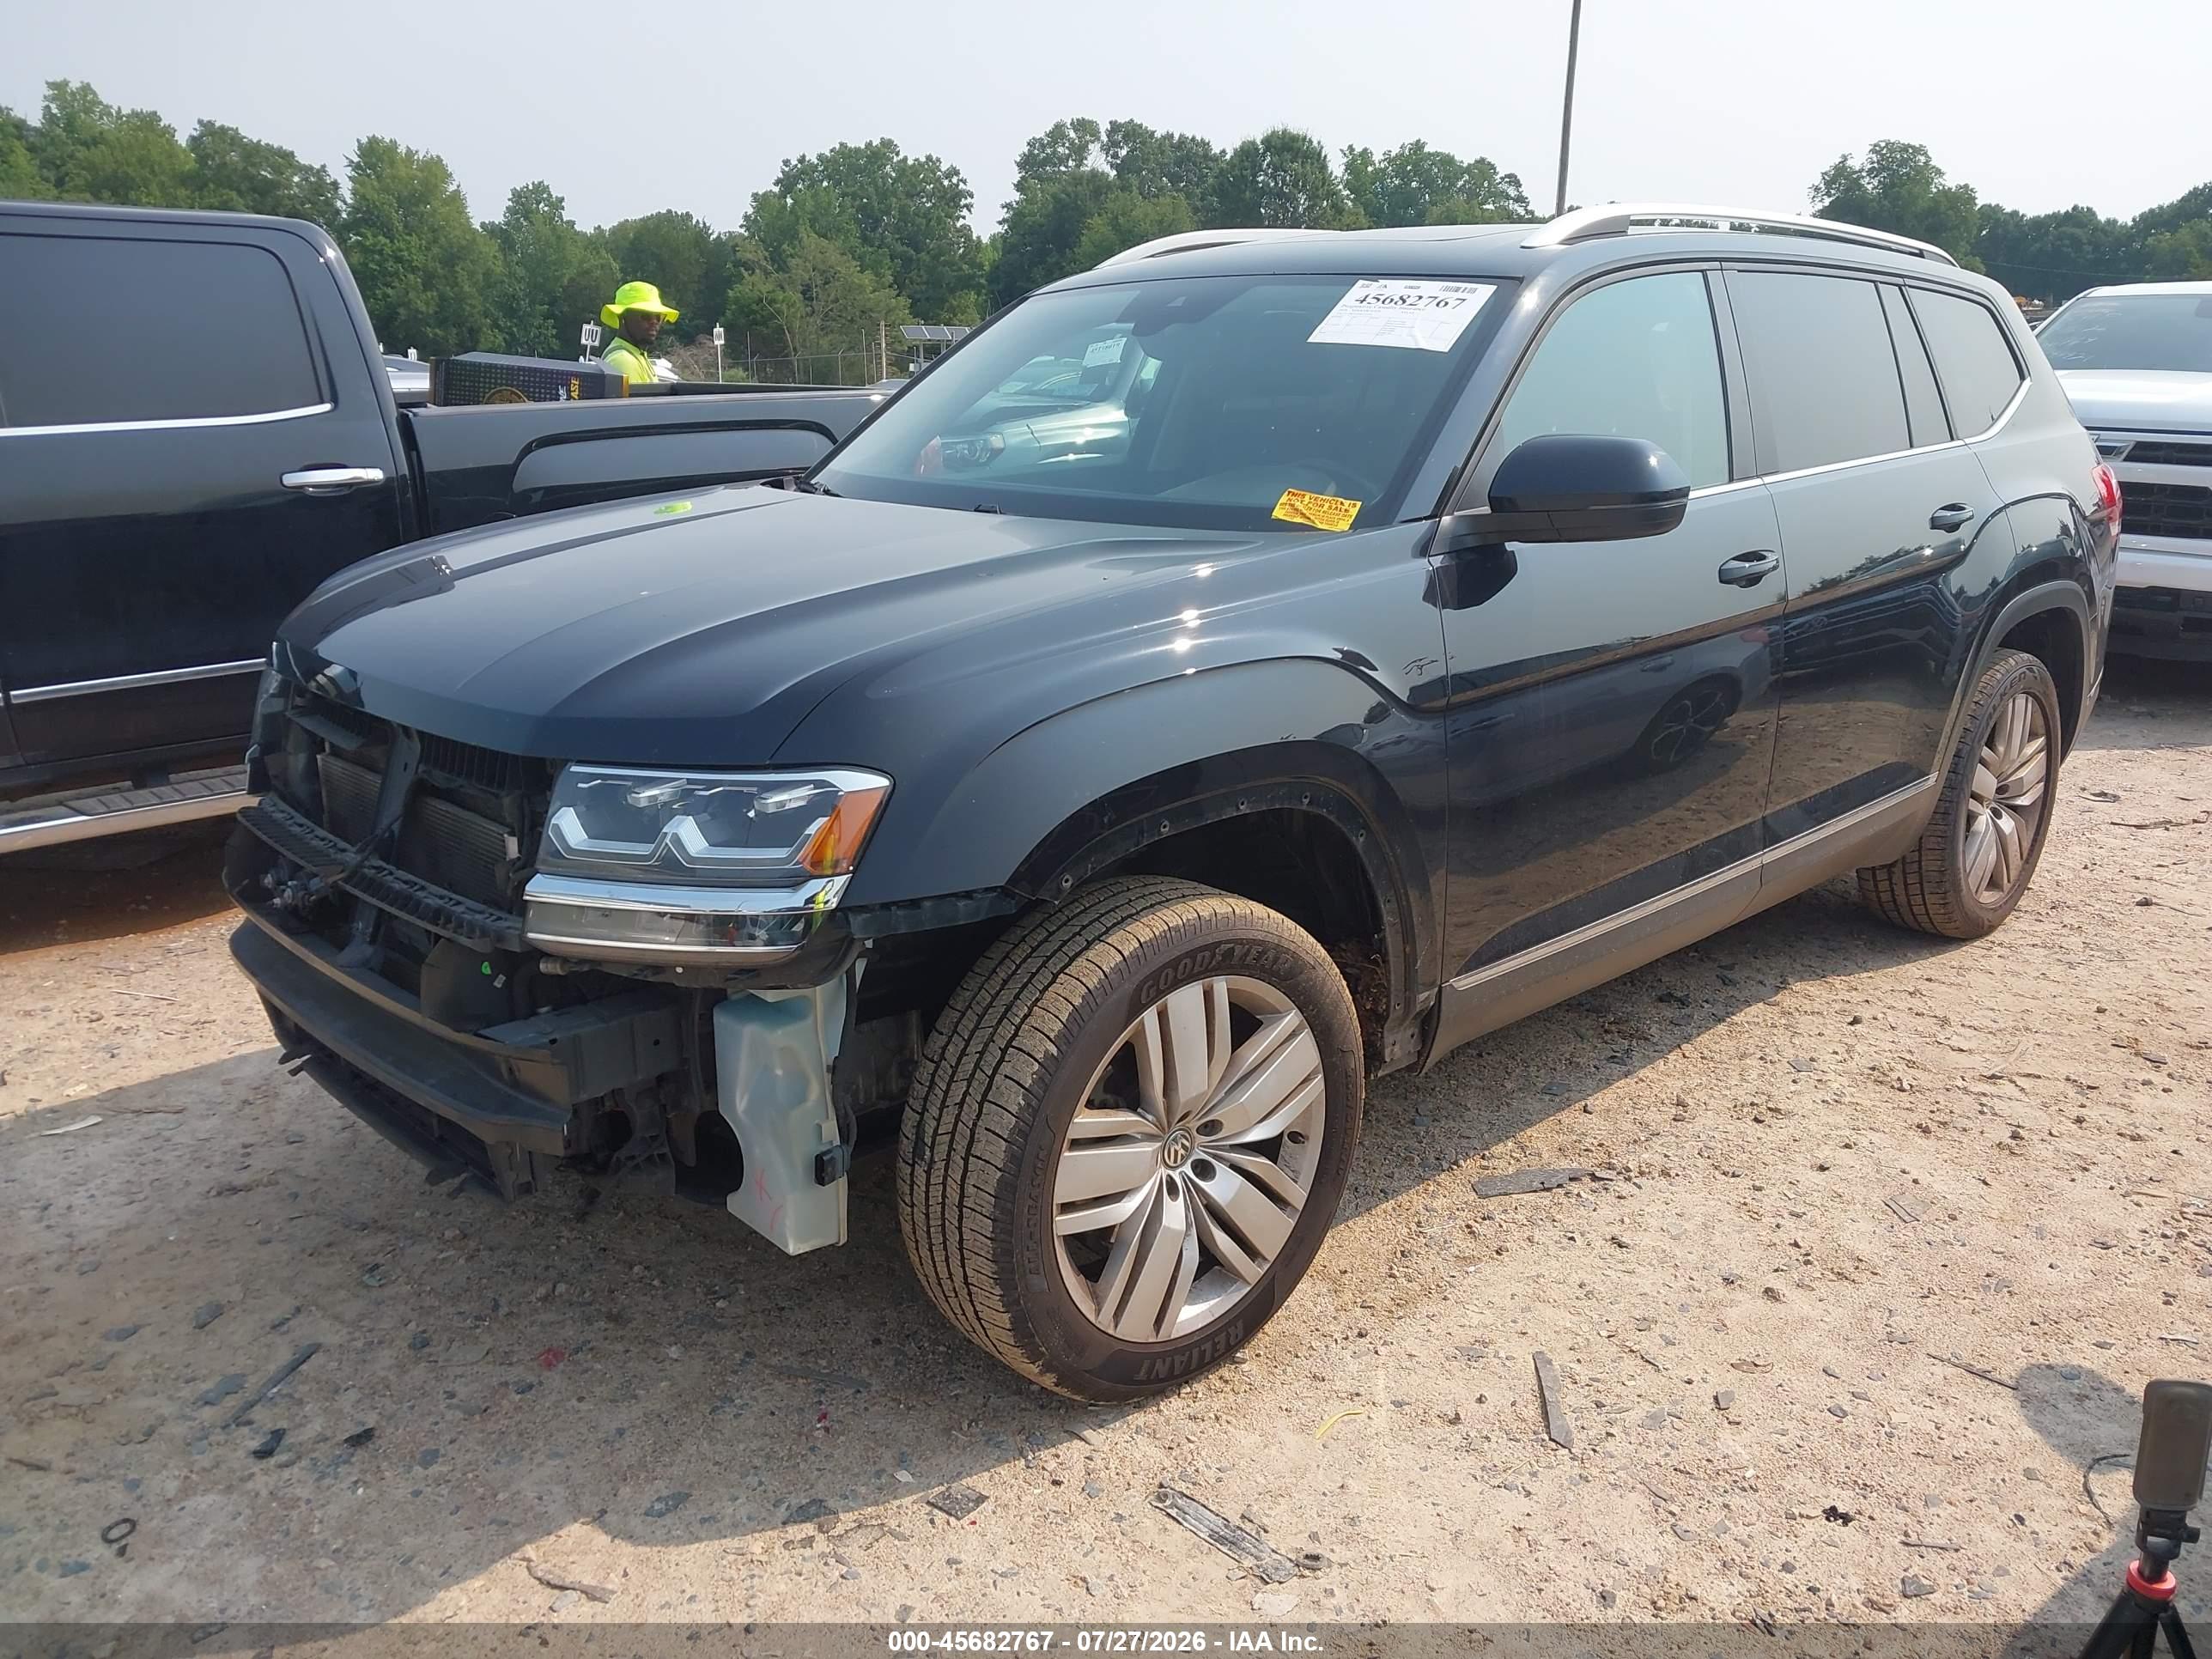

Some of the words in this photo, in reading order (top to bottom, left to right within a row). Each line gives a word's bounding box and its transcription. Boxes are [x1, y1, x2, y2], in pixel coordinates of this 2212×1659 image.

[1354, 293, 1468, 310] 45682767
[584, 327, 600, 343] UU
[1286, 490, 1306, 499] THIS
[1305, 501, 1325, 509] FOR
[1327, 505, 1350, 514] SALE
[1140, 945, 1295, 1004] GOODYEAR
[1133, 1319, 1244, 1381] RELIANT
